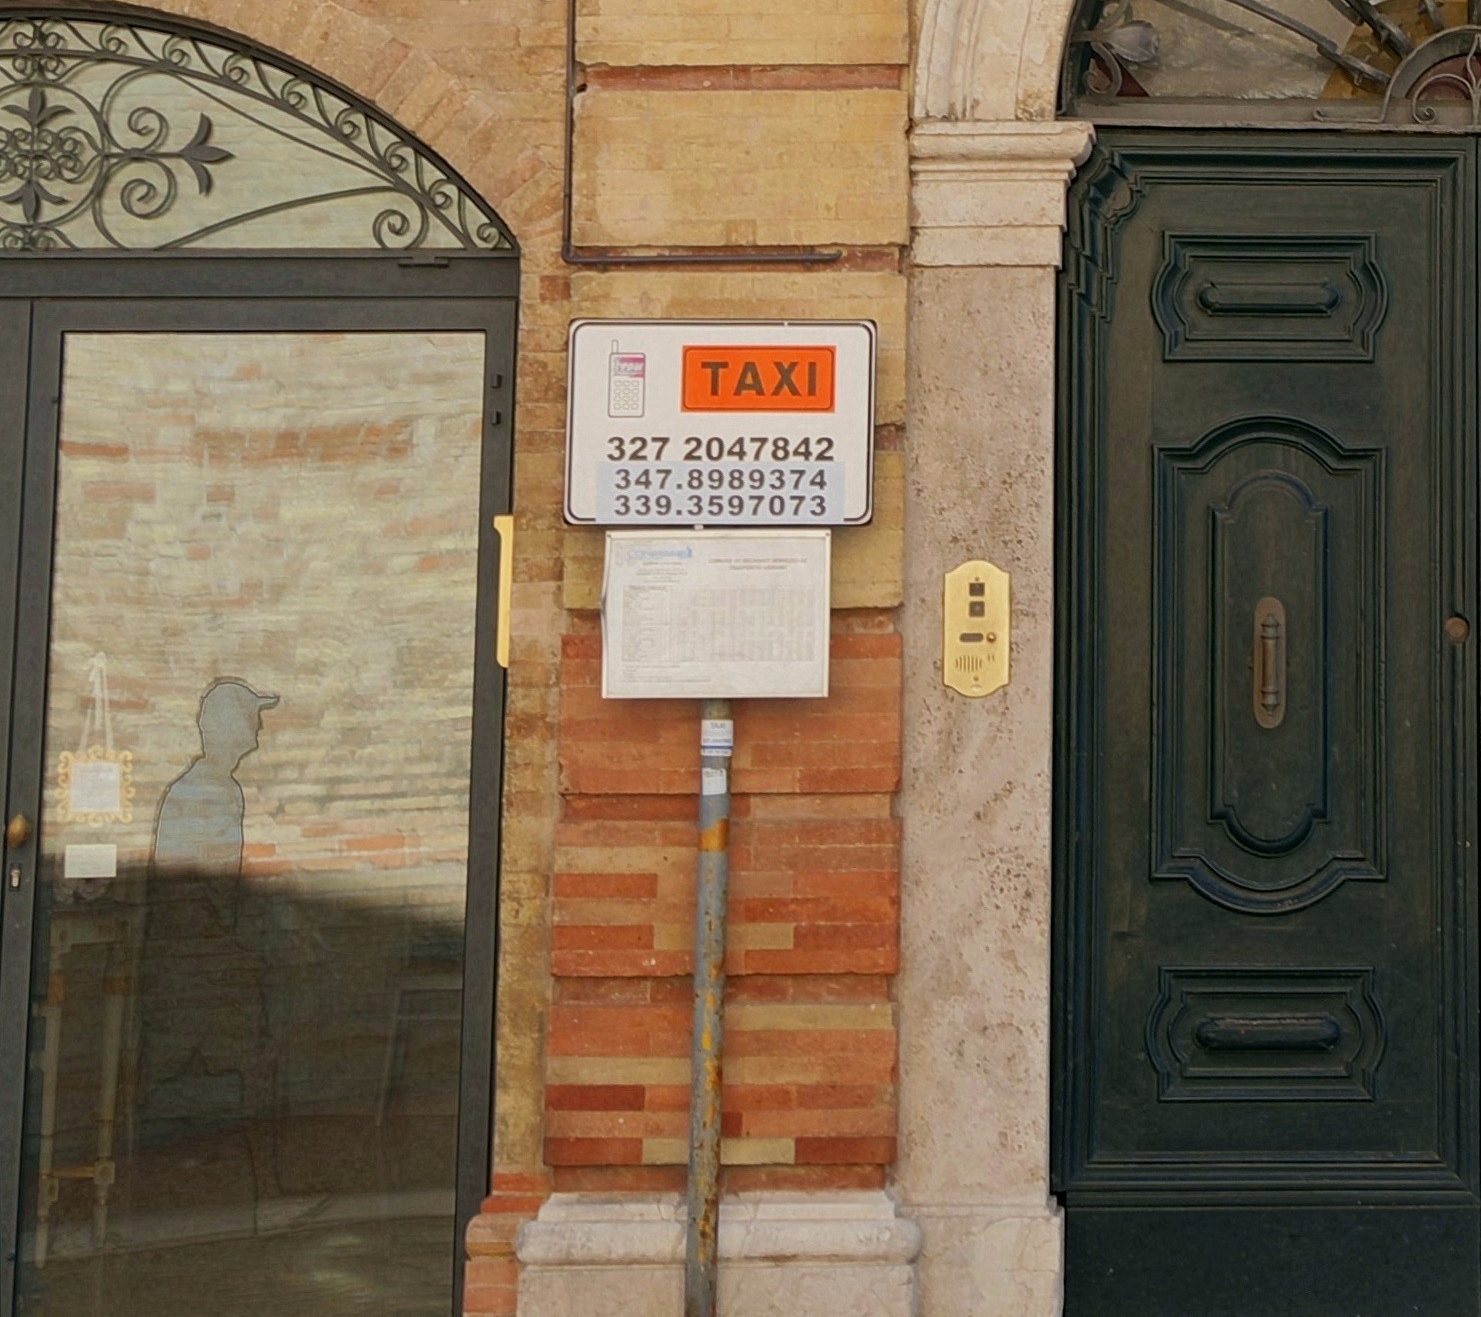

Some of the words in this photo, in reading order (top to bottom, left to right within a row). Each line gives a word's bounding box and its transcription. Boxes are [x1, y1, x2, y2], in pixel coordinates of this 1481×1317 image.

[700, 360, 819, 397] TAXI
[606, 436, 671, 462] 327
[683, 436, 835, 462] 2047842
[614, 468, 828, 491] 347.8989374
[613, 494, 827, 517] 339.3597073
